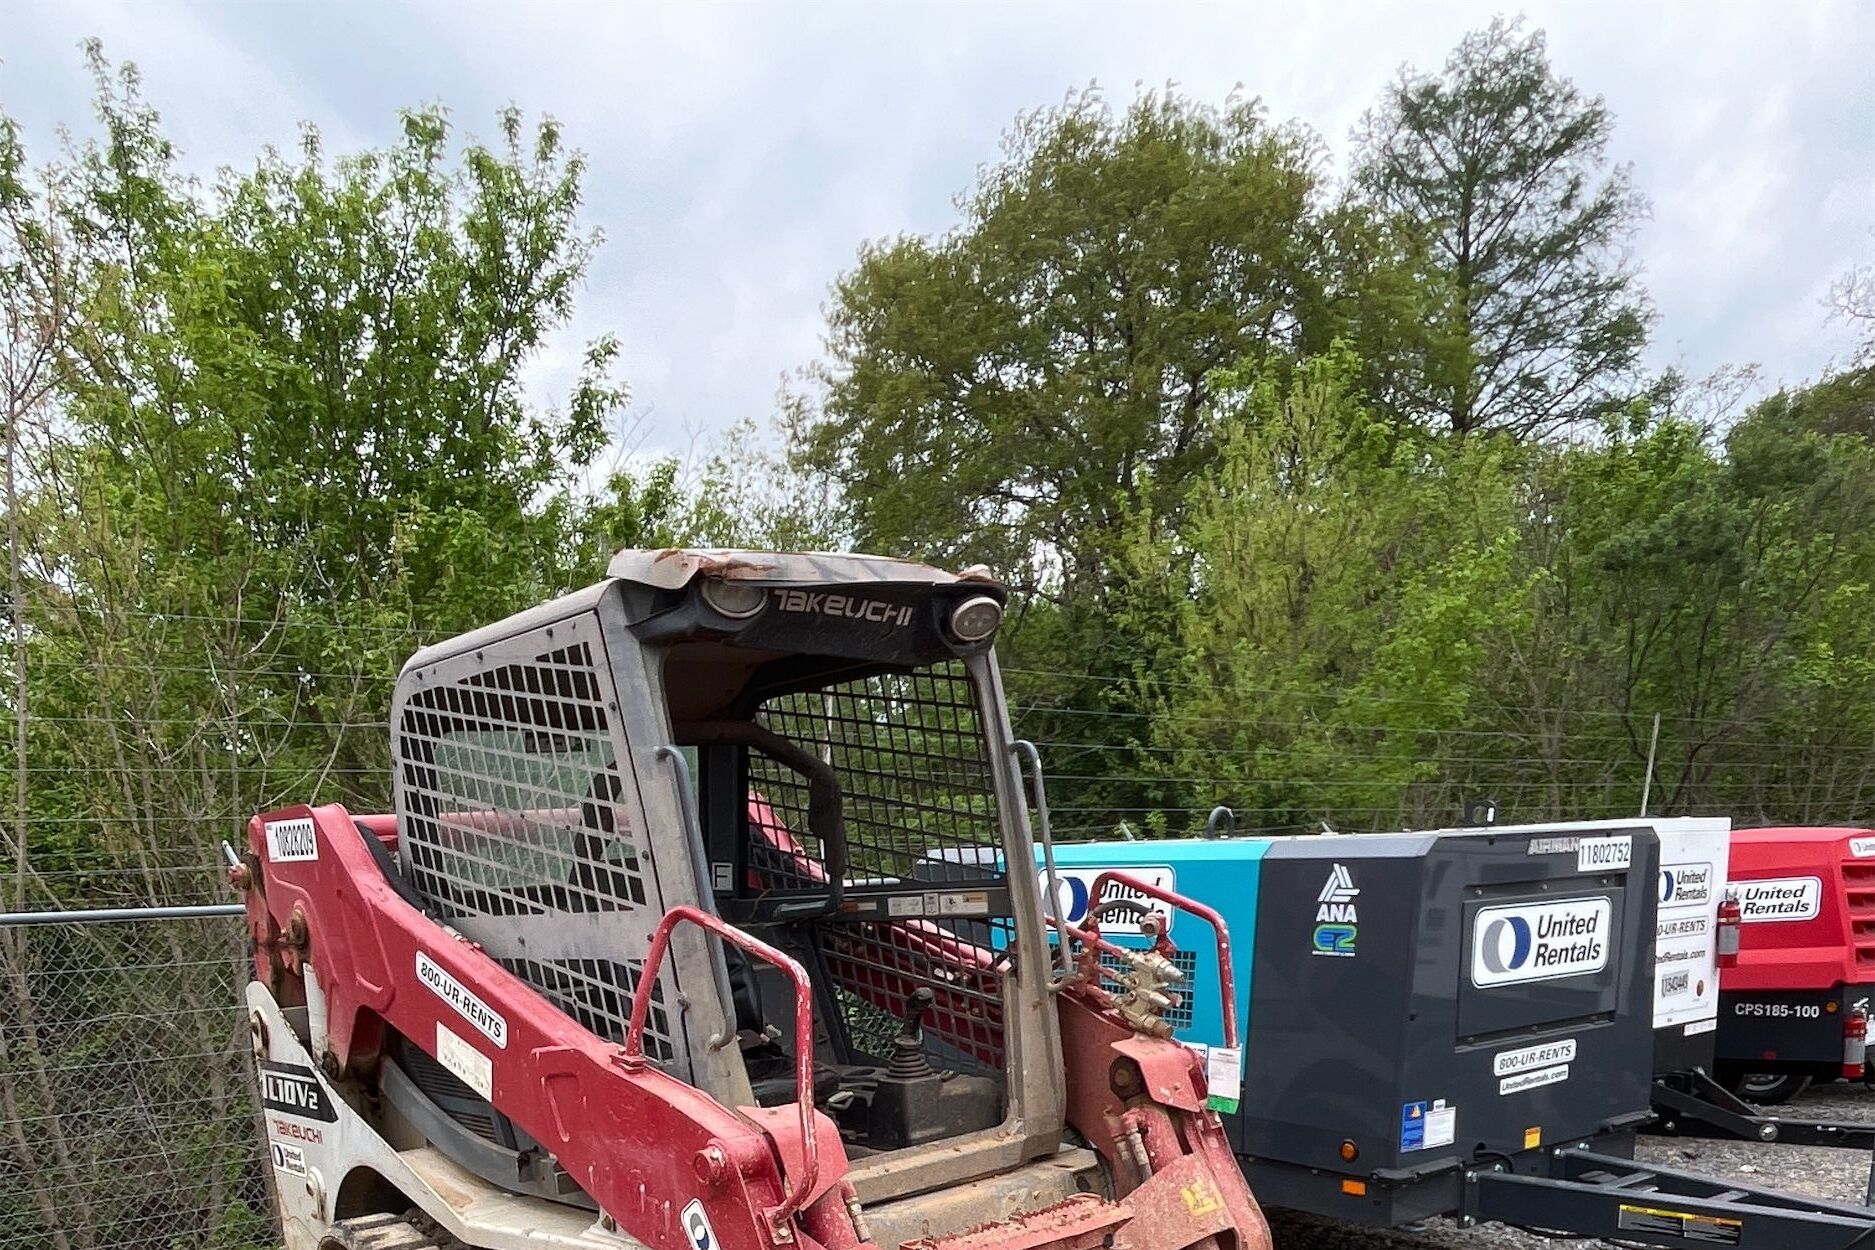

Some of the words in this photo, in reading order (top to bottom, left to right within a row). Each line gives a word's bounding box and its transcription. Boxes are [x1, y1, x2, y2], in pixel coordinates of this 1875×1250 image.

[774, 589, 913, 626] TAKEUCHI
[1580, 842, 1630, 865] 11802752
[1676, 869, 1708, 885] United
[1675, 886, 1708, 901] Rentals
[1744, 885, 1806, 900] United
[1316, 904, 1358, 922] ANA
[1743, 900, 1810, 915] Rentals
[1537, 910, 1599, 939] United
[1534, 938, 1601, 968] Rentals
[420, 962, 502, 1038] 800-UR-RENTS
[1735, 1003, 1820, 1018] CPS185-100
[1499, 1045, 1572, 1070] 800-UR-RENTS
[1501, 1070, 1567, 1091] UnitedRentals.com
[273, 1119, 324, 1144] TAKEUCHI
